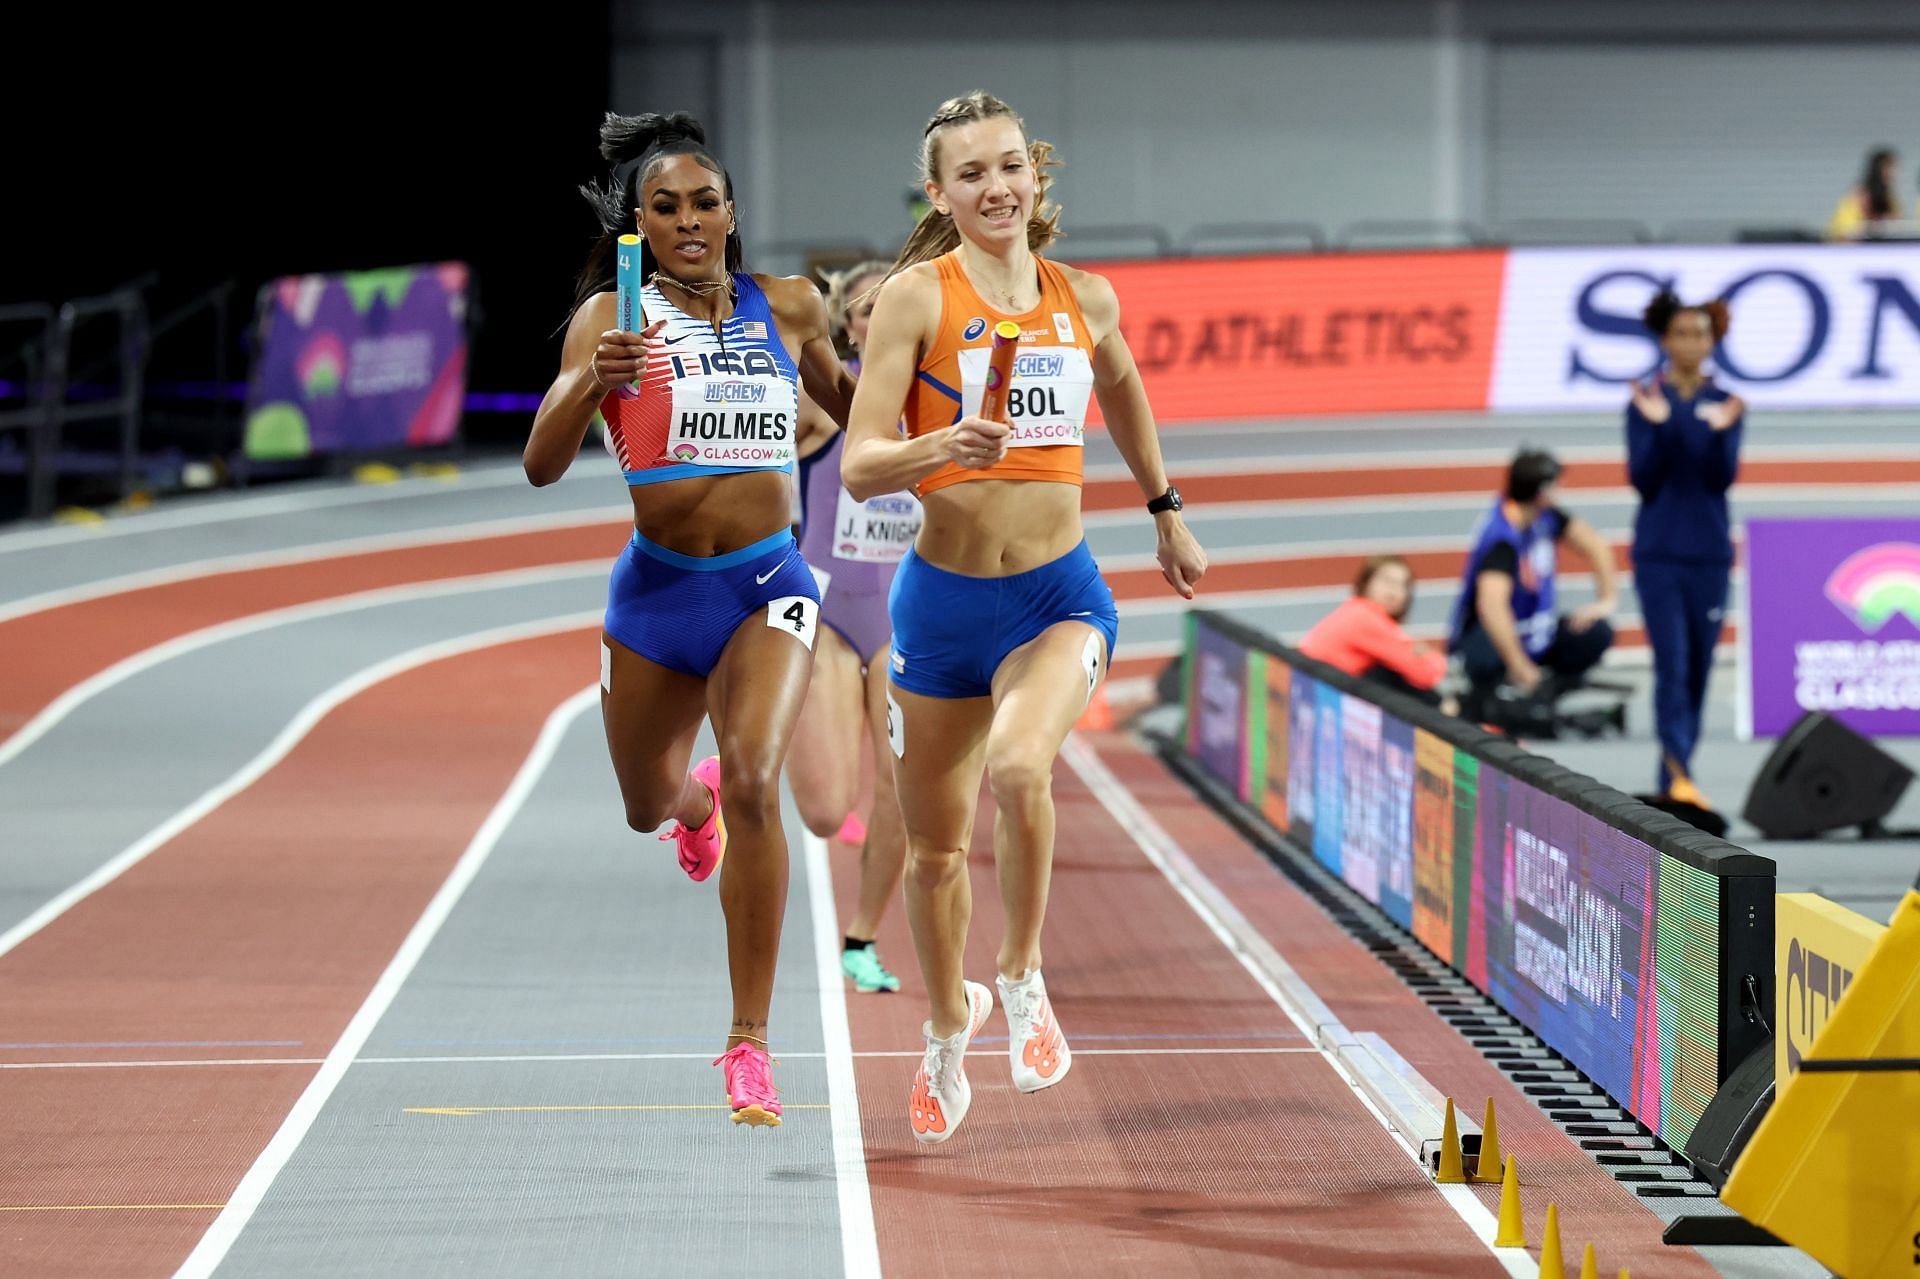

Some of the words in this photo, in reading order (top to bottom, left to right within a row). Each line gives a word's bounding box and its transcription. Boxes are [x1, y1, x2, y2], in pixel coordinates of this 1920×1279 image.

[619, 255, 630, 271] 4
[624, 296, 632, 332] GLASGOW
[1189, 305, 1469, 369] ATHLETICS
[671, 352, 778, 379] USA
[705, 383, 766, 402] HI-CHEW
[1008, 387, 1065, 417] BOL
[680, 413, 787, 440] HOLMES
[704, 448, 773, 460] GLASGOW
[775, 449, 789, 459] 24
[842, 518, 858, 538] J.
[783, 601, 804, 629] 4
